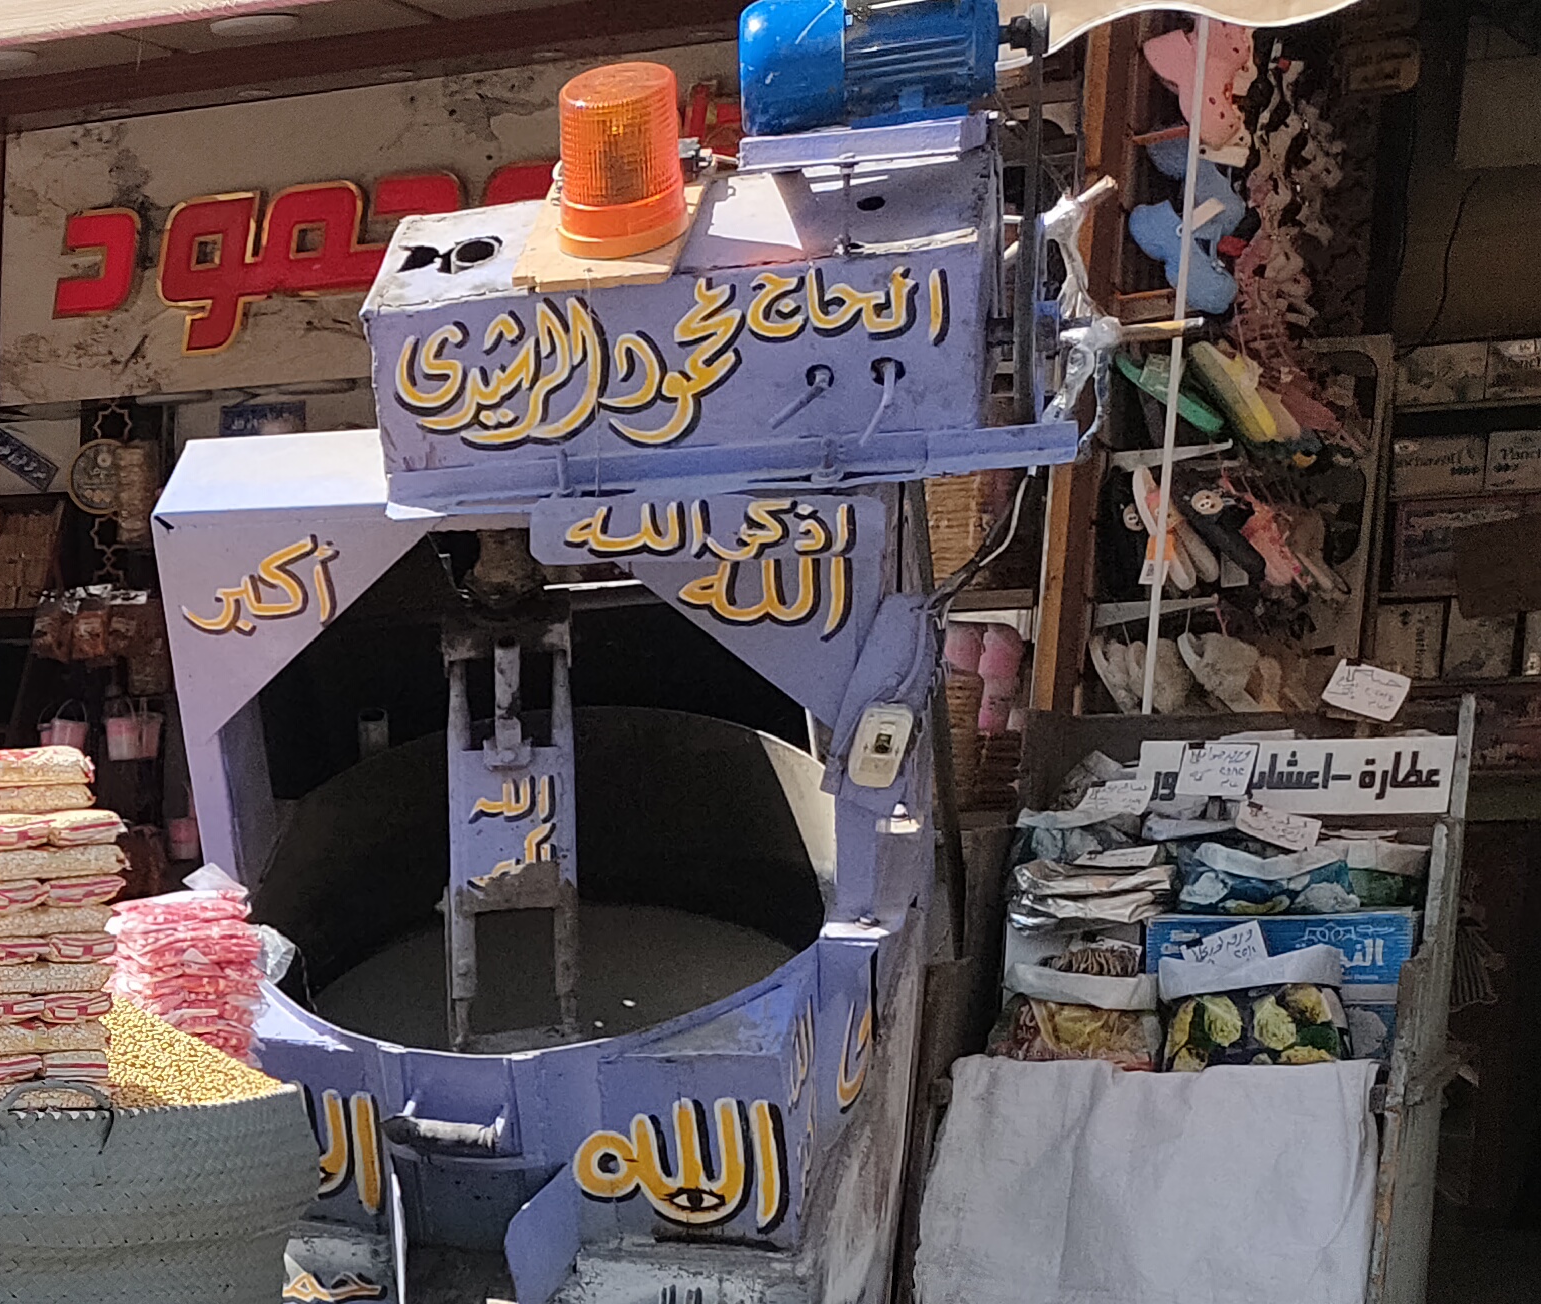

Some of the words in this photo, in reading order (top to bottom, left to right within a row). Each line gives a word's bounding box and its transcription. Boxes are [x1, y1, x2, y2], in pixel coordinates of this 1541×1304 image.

[563, 500, 709, 557] الله
[678, 556, 854, 641] الله
[1358, 750, 1441, 800] عطارة
[571, 1096, 789, 1235] الله
